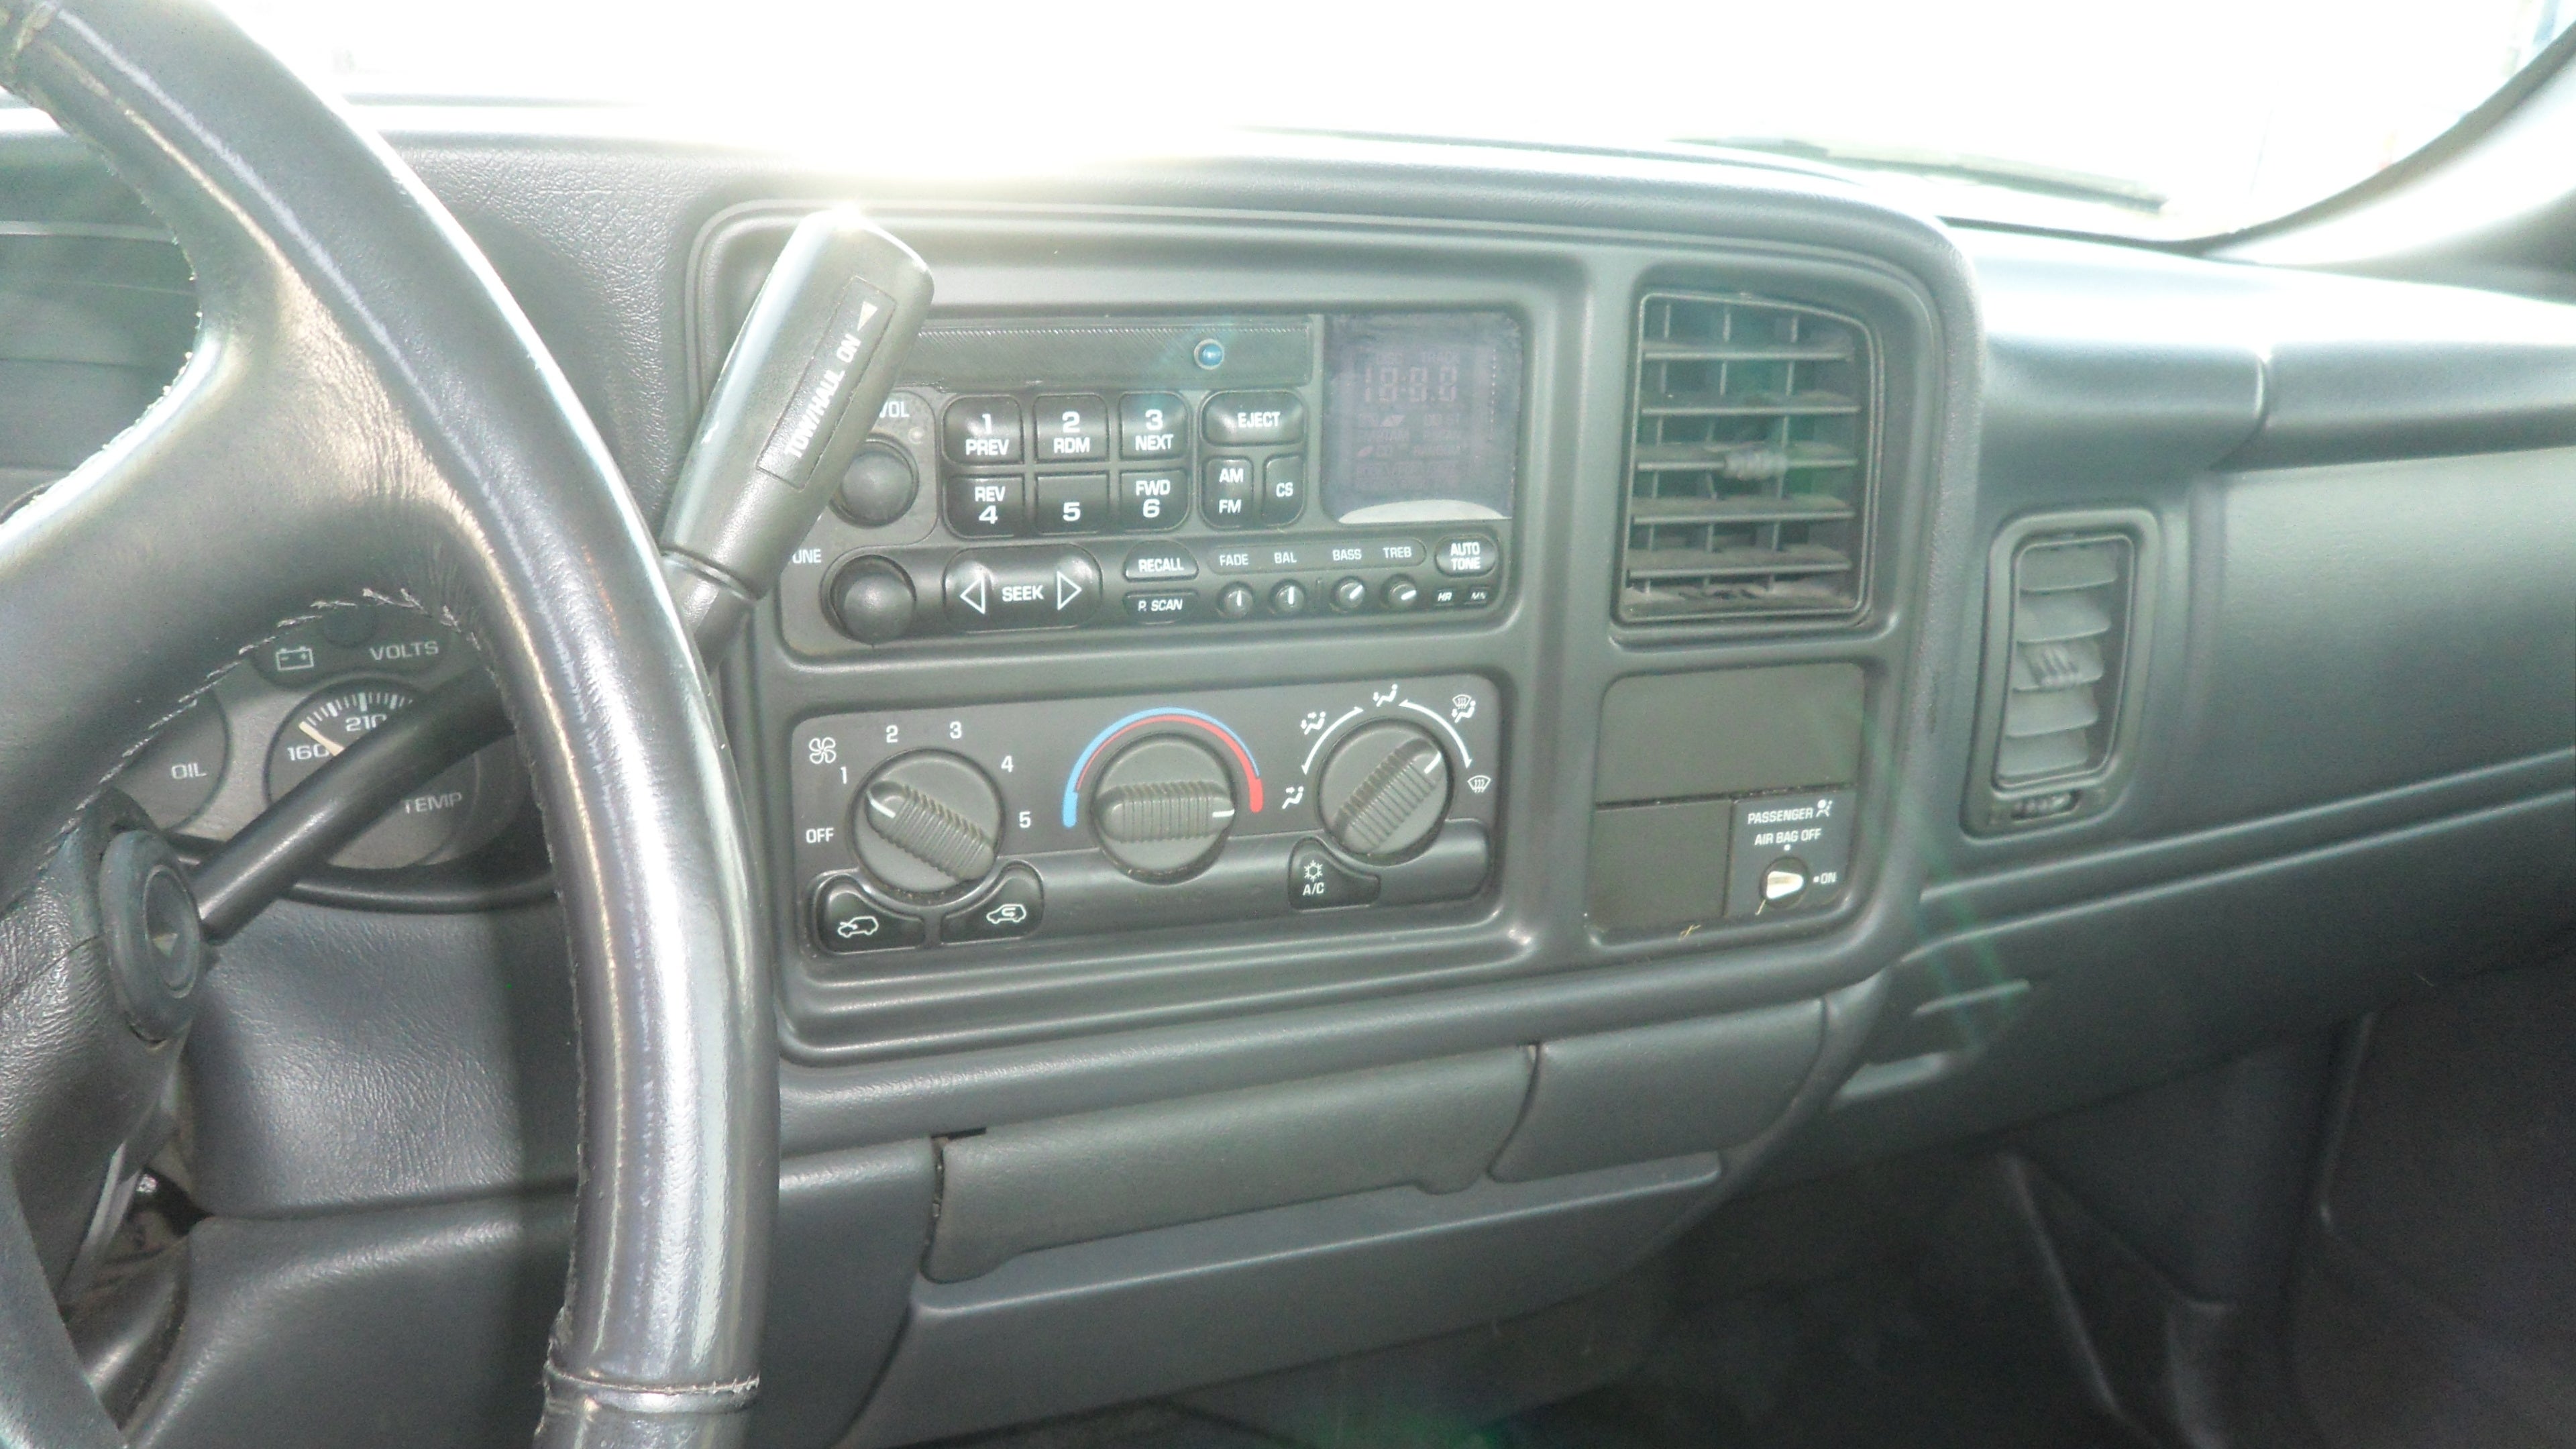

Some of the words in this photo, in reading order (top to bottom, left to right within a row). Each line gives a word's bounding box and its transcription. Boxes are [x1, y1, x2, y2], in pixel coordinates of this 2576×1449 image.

[784, 369, 845, 458] TOW/HAUL
[836, 333, 861, 364] ON
[982, 413, 994, 432] 1
[1062, 411, 1081, 433] 2
[1144, 409, 1163, 430] 3
[1238, 411, 1281, 429] EJECT
[965, 438, 1010, 455] PREV
[1053, 437, 1091, 453] RDM
[1135, 433, 1174, 451] NEXT
[1218, 468, 1244, 483] AM
[975, 486, 1006, 502] REV
[1135, 479, 1171, 496] FWD
[1276, 482, 1293, 497] CS
[1063, 501, 1081, 521] 5
[1142, 498, 1161, 518] 6
[1218, 498, 1242, 514] FM
[979, 506, 998, 524] 4
[792, 548, 822, 564] UNE
[1332, 548, 1362, 561] BASS
[1383, 546, 1412, 559] TREB
[1450, 541, 1481, 556] AUTO
[1138, 557, 1185, 573] RECALL
[1219, 553, 1249, 567] FADE
[1274, 551, 1297, 565] BAL
[1450, 556, 1481, 570] TONE
[1002, 584, 1044, 602] SEEK
[1437, 591, 1452, 602] HR
[1150, 598, 1183, 611] SCAN
[370, 641, 439, 661] VOLTS
[885, 724, 899, 743] 2
[949, 720, 963, 739] 3
[287, 743, 331, 761] 160
[171, 762, 207, 780] OIL
[1001, 755, 1014, 773] 4
[840, 766, 848, 784] 1
[1019, 810, 1032, 828] 5
[1748, 807, 1813, 825] PASSENGER
[806, 827, 835, 844] OFF
[1754, 833, 1774, 846] AIR
[1776, 830, 1799, 845] BAG
[1801, 828, 1822, 842] OFF
[1820, 872, 1837, 884] ON
[1303, 881, 1325, 896] A/C
